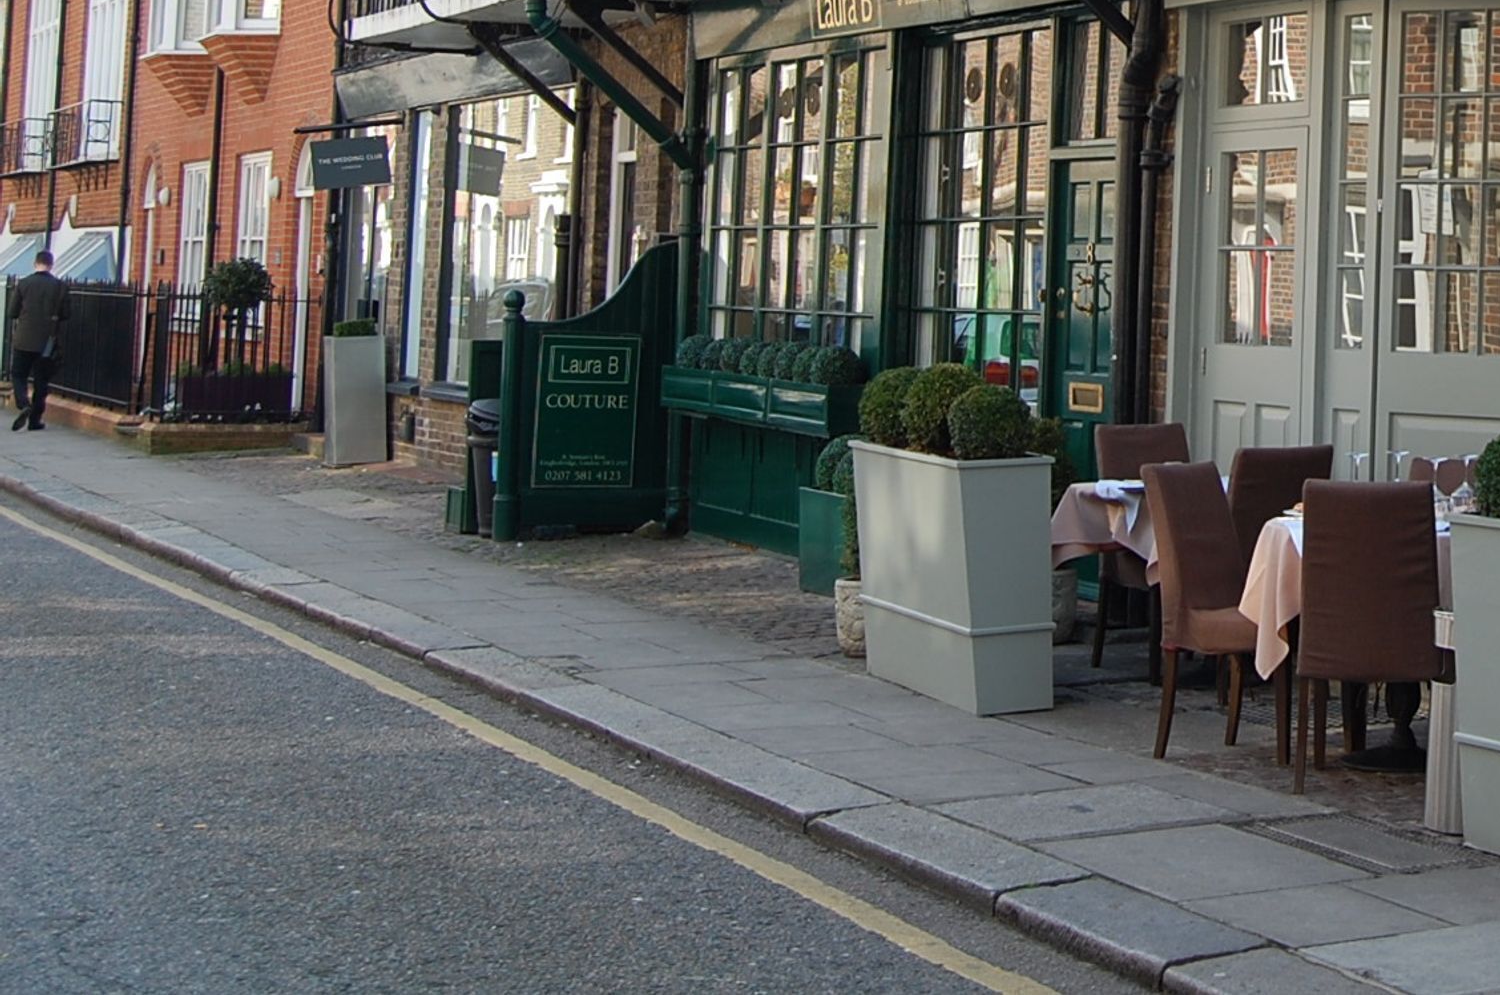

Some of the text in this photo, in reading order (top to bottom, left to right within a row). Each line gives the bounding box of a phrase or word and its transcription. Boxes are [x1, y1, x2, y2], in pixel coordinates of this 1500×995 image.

[332, 155, 364, 164] WEDDING
[1086, 242, 1094, 264] 8
[561, 354, 620, 375] Laura B
[546, 393, 630, 409] COUTURE
